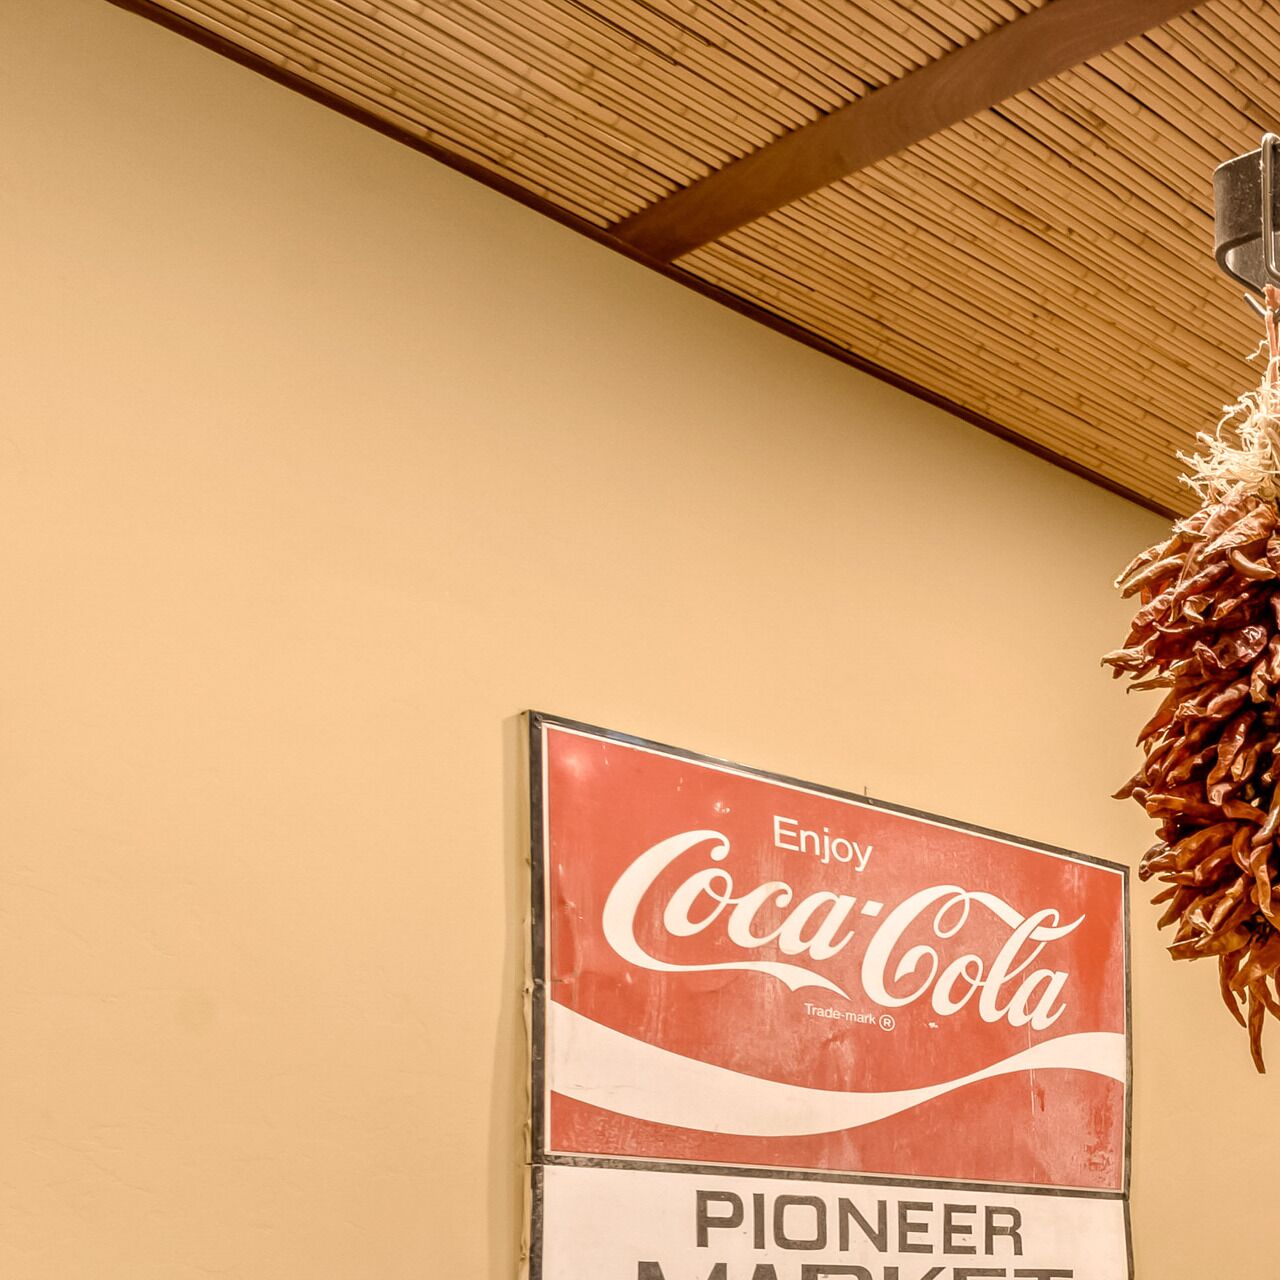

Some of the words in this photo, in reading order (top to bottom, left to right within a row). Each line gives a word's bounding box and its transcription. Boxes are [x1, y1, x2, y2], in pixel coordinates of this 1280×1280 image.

[773, 816, 873, 872] Enjoy
[602, 829, 1086, 1031] Coca-Cola
[803, 1001, 877, 1027] Trade-mark
[695, 1188, 1024, 1257] PIONEER
